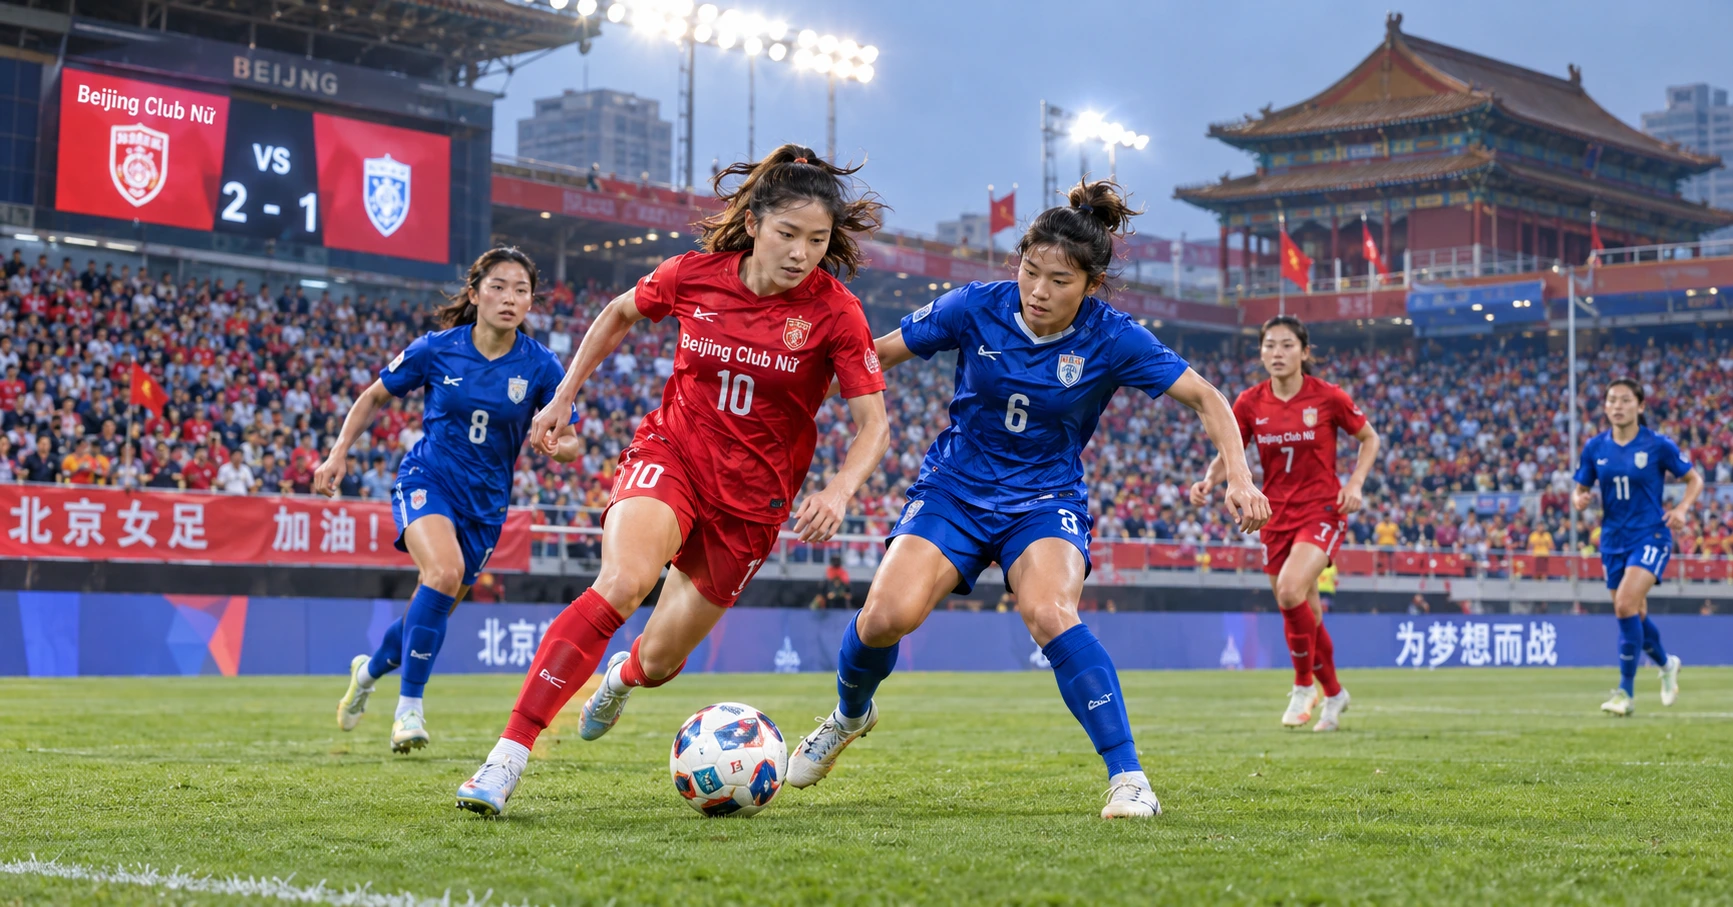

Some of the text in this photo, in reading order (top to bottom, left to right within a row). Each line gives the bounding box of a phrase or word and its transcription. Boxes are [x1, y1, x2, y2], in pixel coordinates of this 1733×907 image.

[233, 55, 338, 95] BEIJNG
[77, 84, 139, 116] Beijing
[144, 96, 185, 120] Club
[252, 142, 291, 175] VS
[221, 181, 248, 223] 2
[298, 192, 317, 233] 1
[681, 332, 733, 363] Beijing
[735, 346, 771, 368] Club
[717, 369, 755, 416] 10
[468, 409, 489, 444] 8
[1004, 393, 1030, 433] 6
[624, 460, 665, 491] 10
[1280, 446, 1294, 473] 7
[1613, 475, 1630, 501] 11
[8, 496, 208, 550] 北京女足
[477, 617, 555, 667] 北京
[1395, 620, 1558, 667] 为梦想而战
